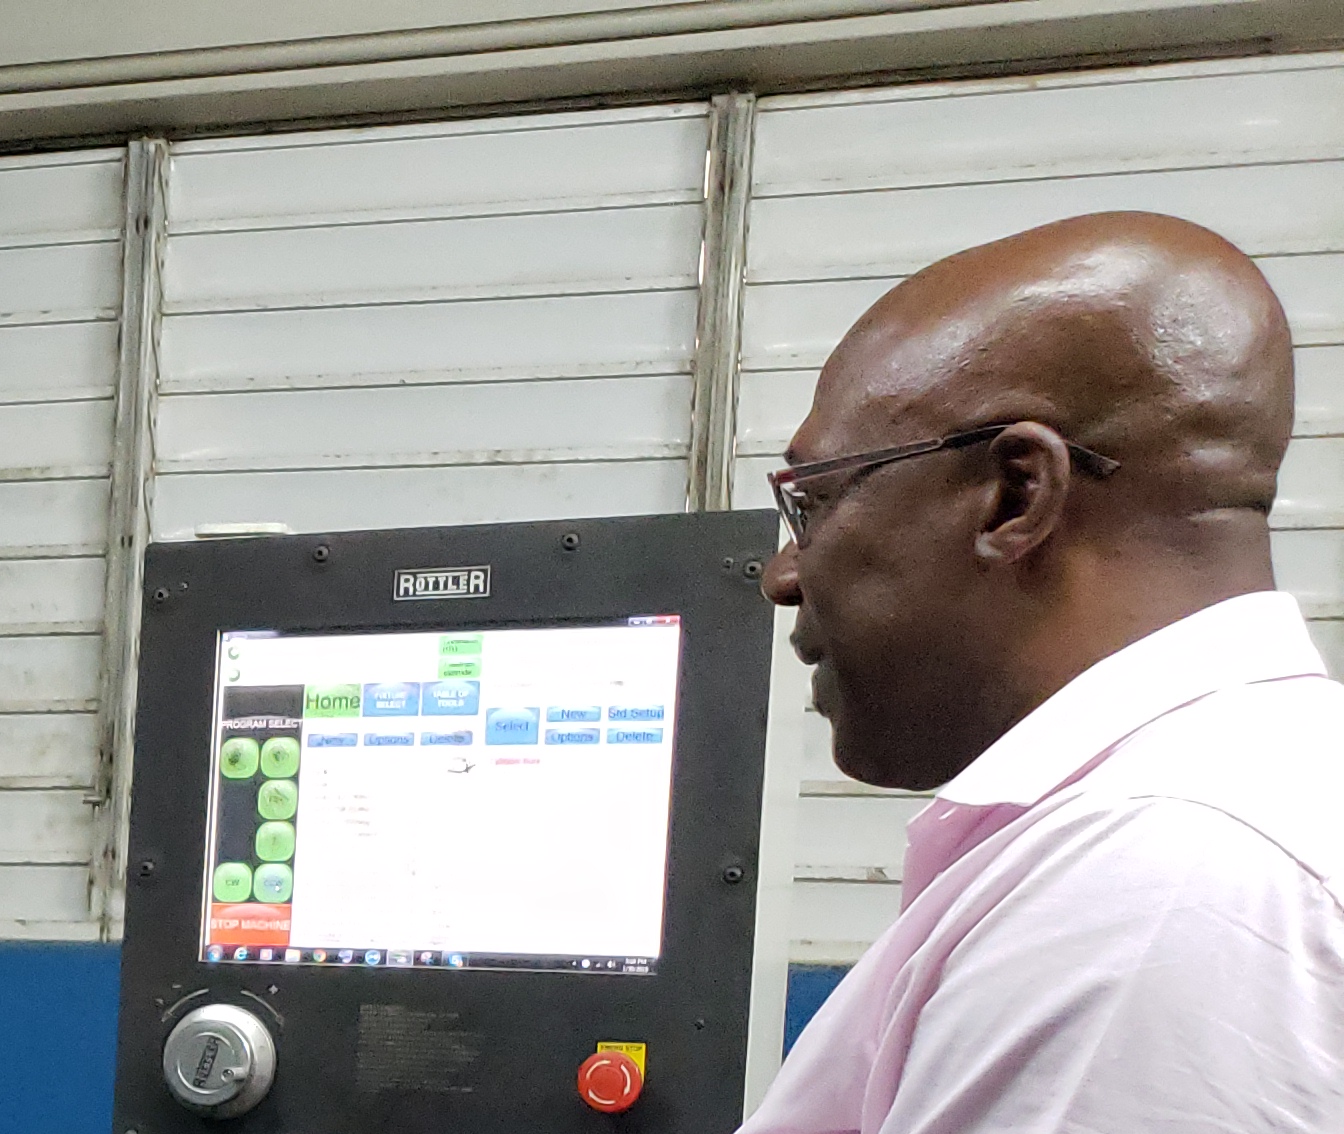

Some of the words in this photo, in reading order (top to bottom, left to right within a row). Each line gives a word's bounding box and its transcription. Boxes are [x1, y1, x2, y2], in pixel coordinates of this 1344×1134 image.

[398, 570, 485, 597] ROTTLER
[306, 693, 361, 710] Home
[561, 709, 587, 719] New
[630, 708, 664, 720] Setup
[222, 720, 267, 730] PROGRAM
[268, 719, 304, 729] SELECT
[495, 721, 530, 732] Select
[550, 731, 594, 743] Options
[616, 731, 655, 742] Delete
[210, 919, 239, 930] STOP
[241, 919, 291, 931] MACHINE
